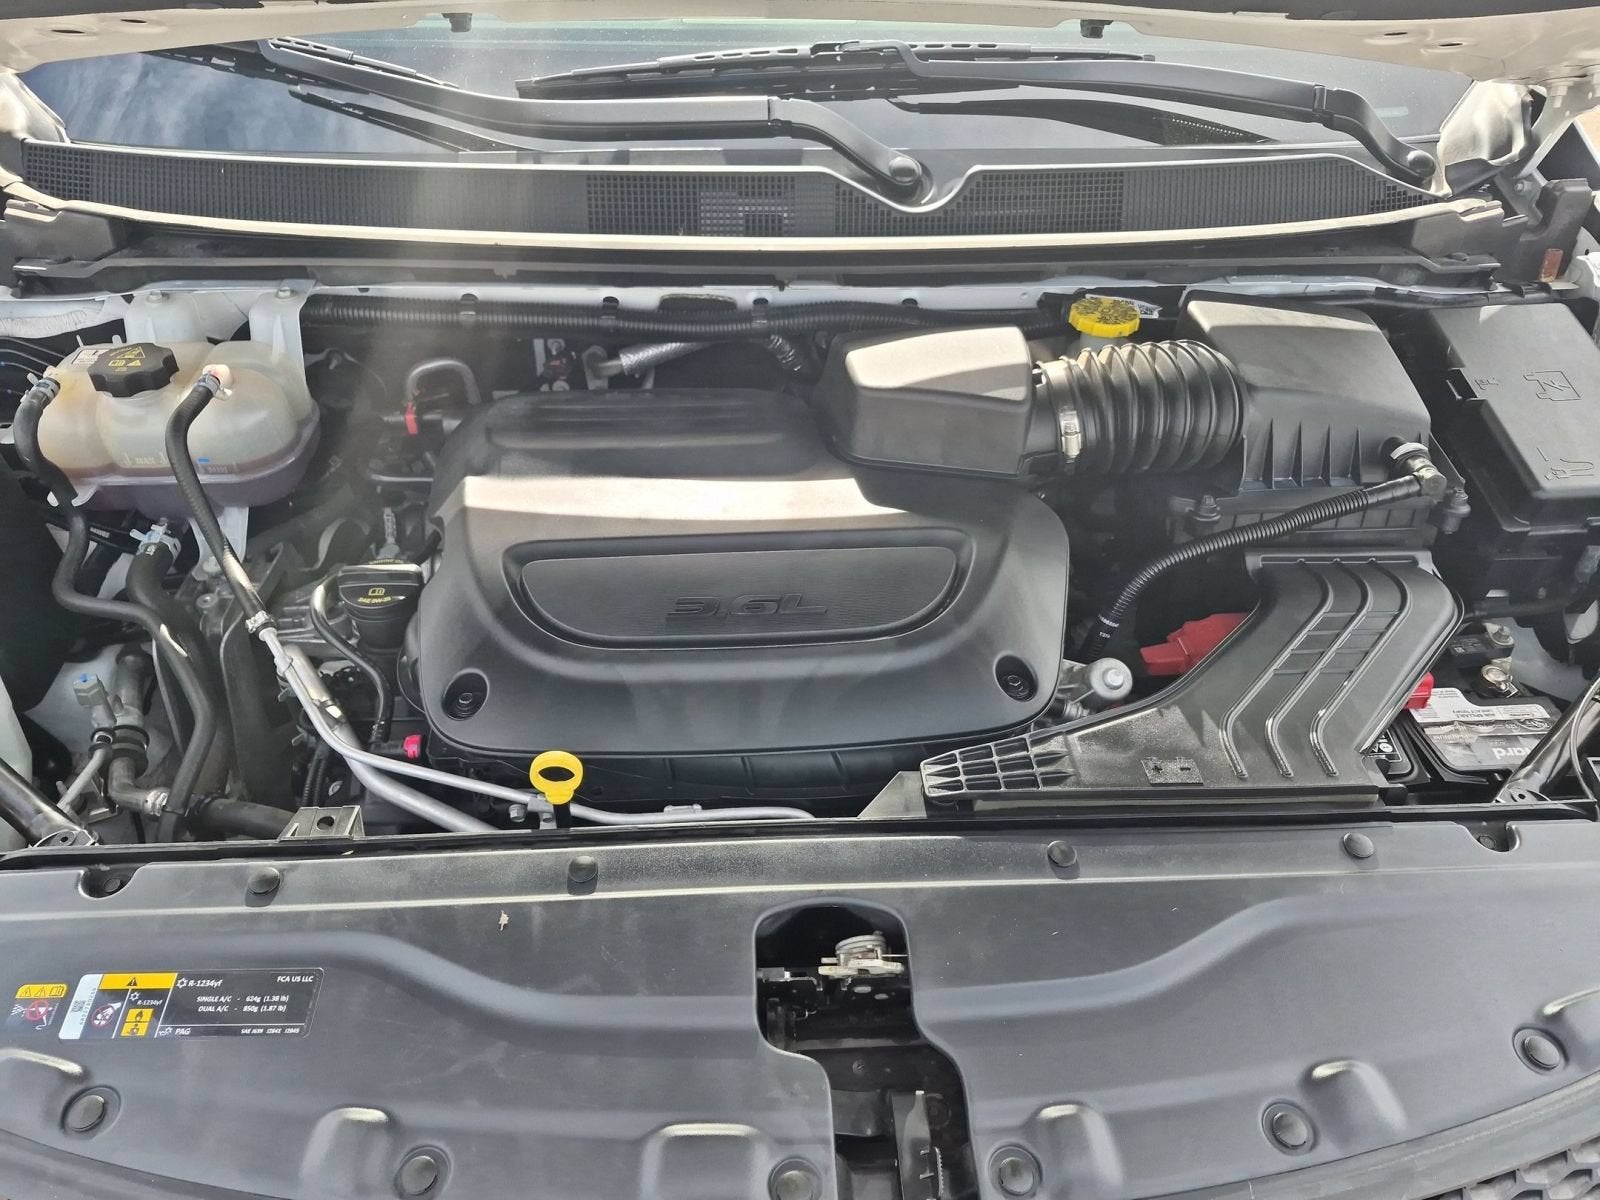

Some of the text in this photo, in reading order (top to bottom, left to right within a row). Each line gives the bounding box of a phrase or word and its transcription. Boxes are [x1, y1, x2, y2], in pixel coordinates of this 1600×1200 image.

[666, 593, 828, 617] 3.6L
[276, 975, 314, 983] FCA US LLC
[188, 979, 223, 988] R-1234yf
[196, 995, 219, 1003] SINGLE
[219, 995, 232, 1003] A/C
[245, 995, 261, 1003] 624g
[263, 995, 280, 1003] (1.38
[215, 1005, 229, 1013] A/C
[242, 1005, 259, 1013] 850g
[260, 1005, 277, 1013] (1.87
[174, 1027, 191, 1036] PAG
